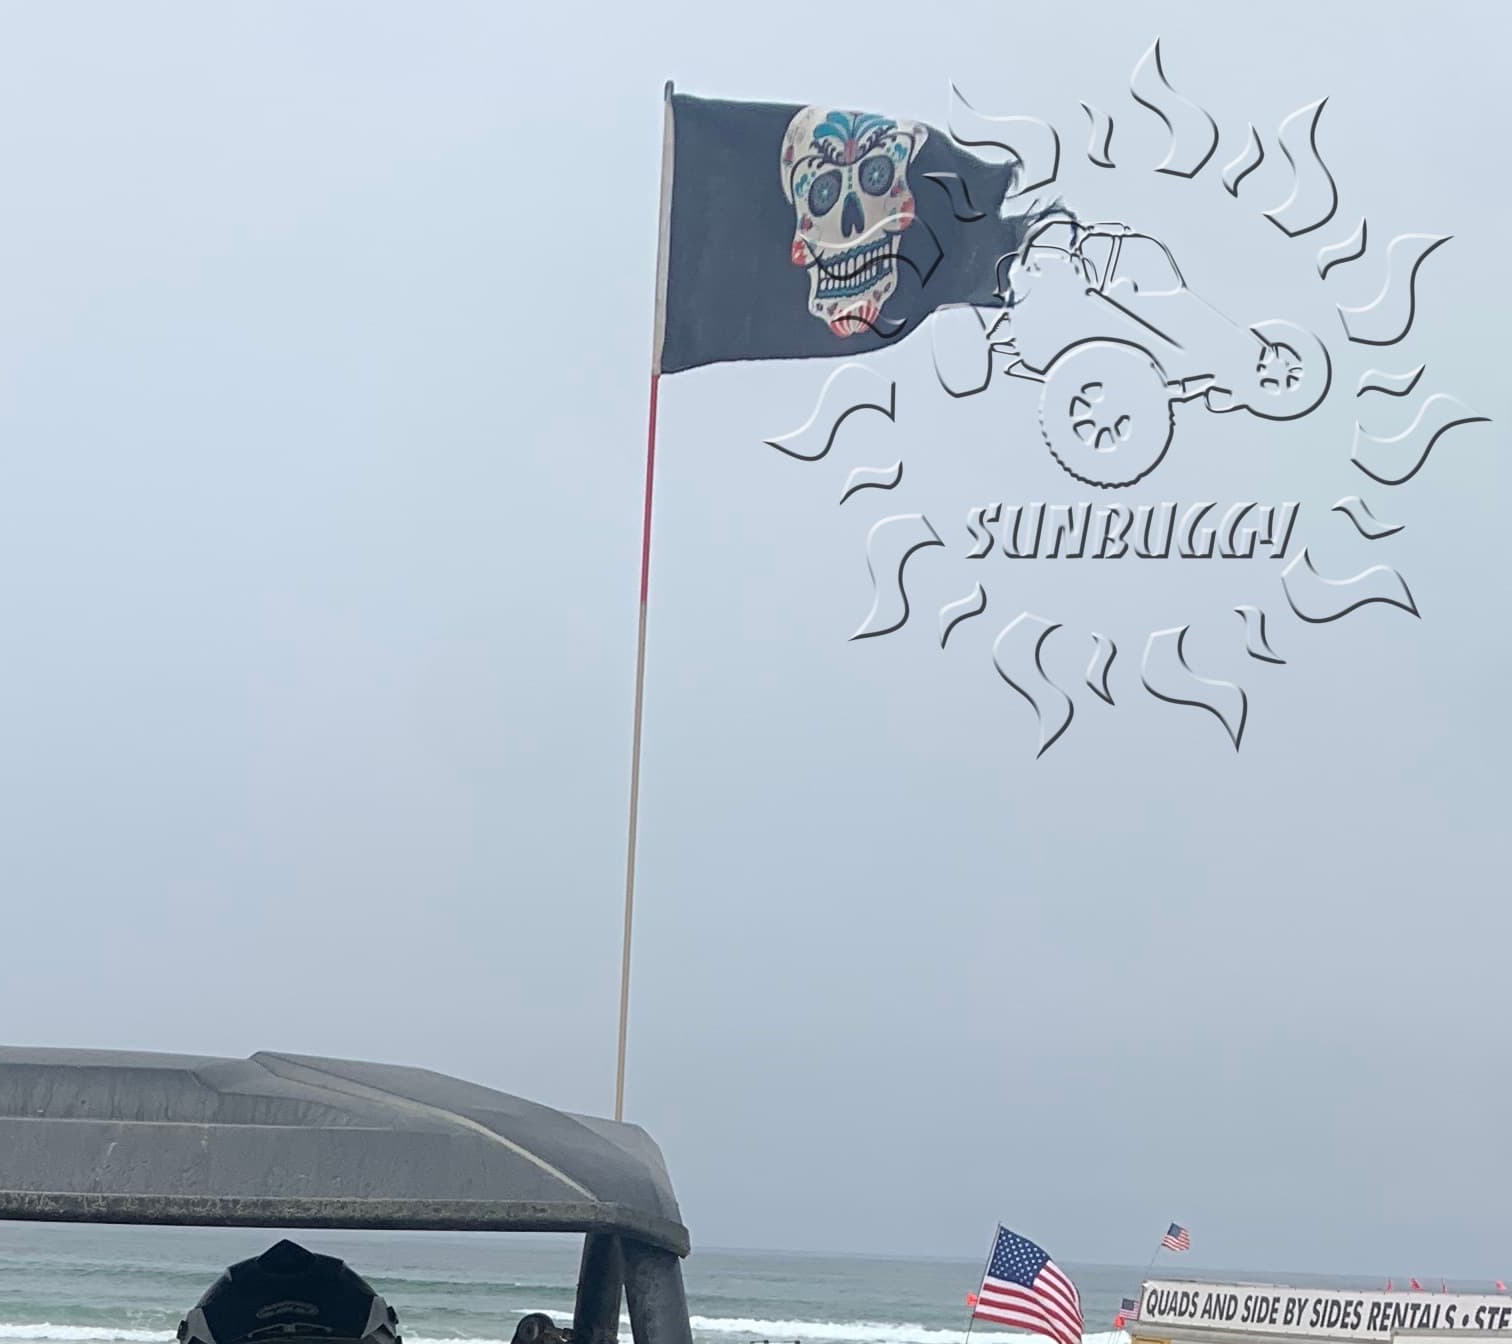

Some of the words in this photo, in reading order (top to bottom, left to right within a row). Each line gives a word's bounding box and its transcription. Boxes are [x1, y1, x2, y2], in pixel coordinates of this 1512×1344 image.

[1146, 1288, 1199, 1318] QUADS
[1200, 1293, 1238, 1321] AND
[1241, 1294, 1280, 1325] SIDE
[1283, 1297, 1309, 1327] BY
[1309, 1298, 1364, 1331] SIDES
[1367, 1301, 1457, 1331] RENTALS
